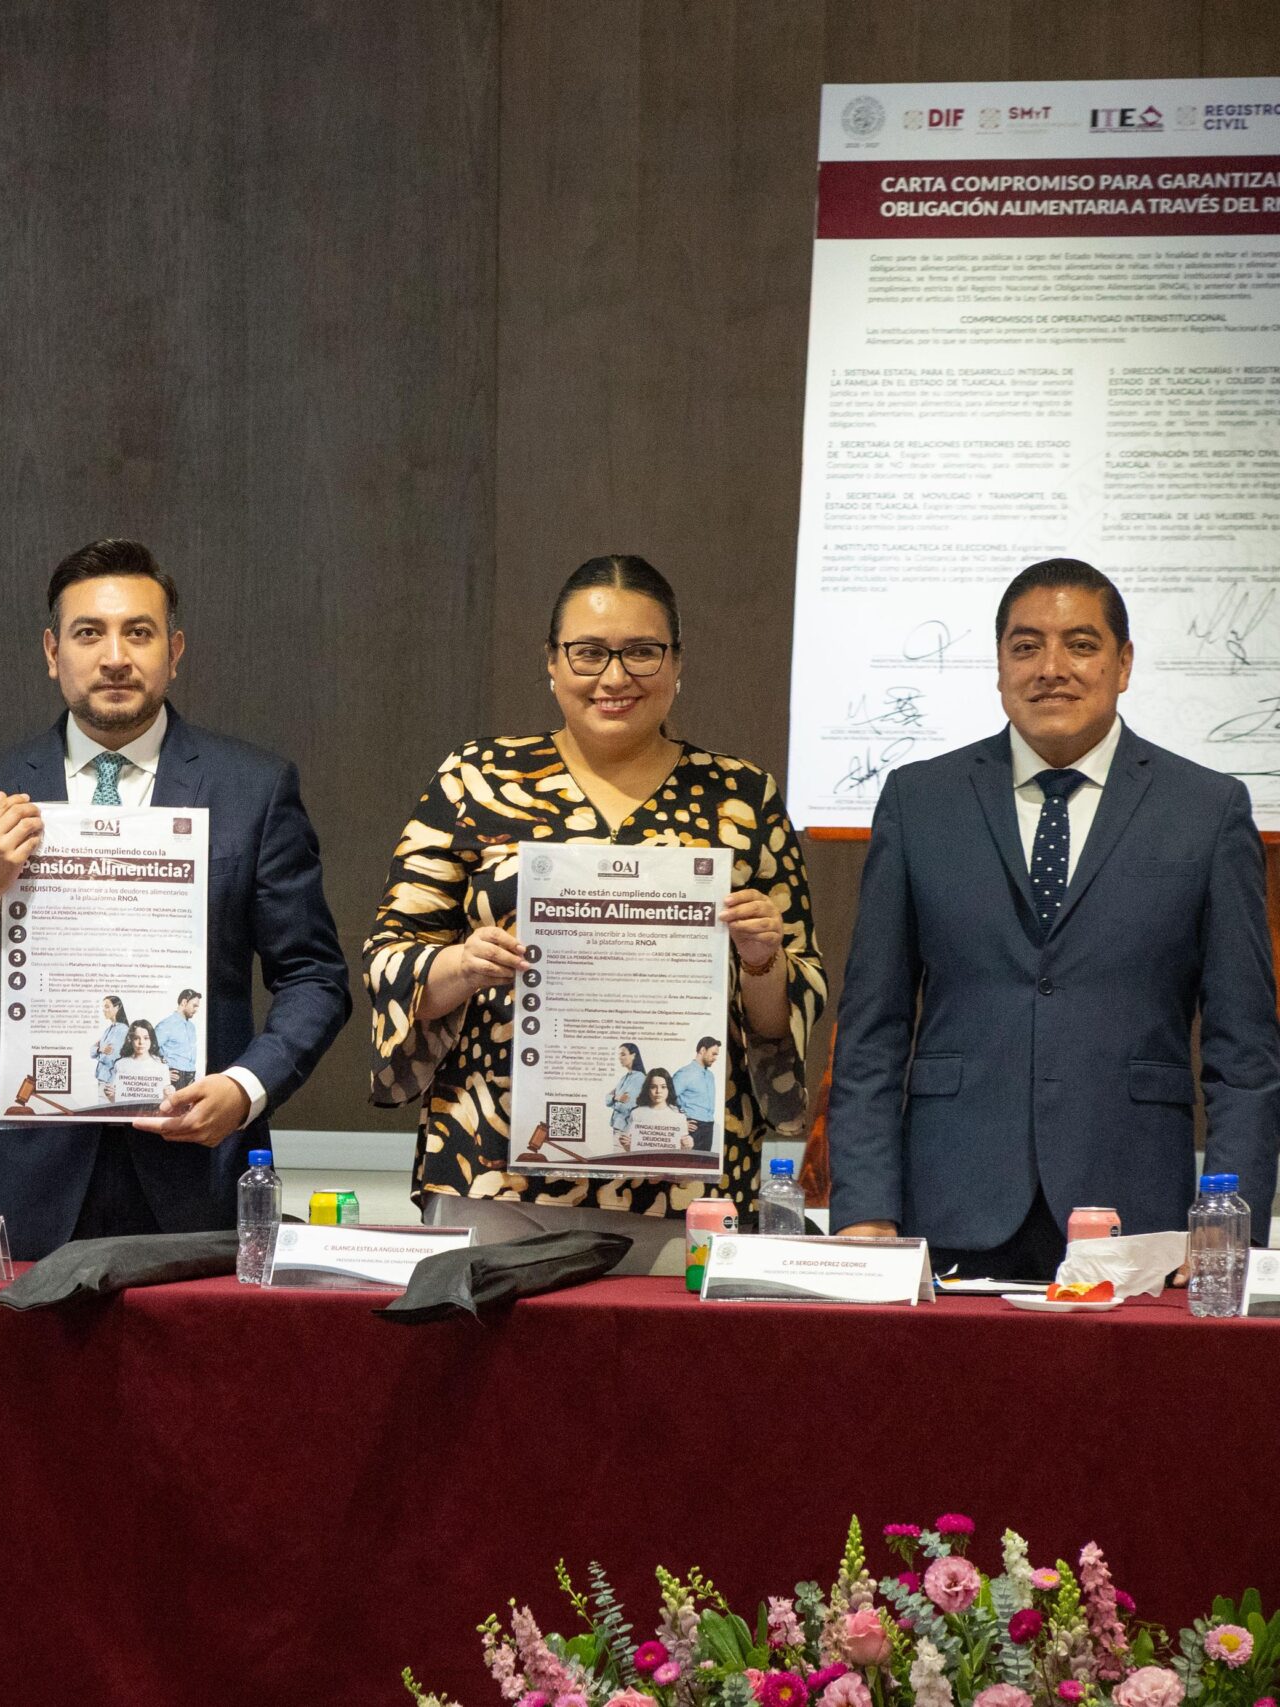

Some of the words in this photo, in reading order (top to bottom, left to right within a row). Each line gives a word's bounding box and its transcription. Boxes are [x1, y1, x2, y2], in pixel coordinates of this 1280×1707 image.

[928, 109, 965, 127] DIF
[1090, 108, 1137, 128] ITE
[1203, 118, 1249, 130] CIVIL
[880, 176, 947, 193] CARTA
[950, 174, 1095, 193] COMPROMISO
[1099, 174, 1153, 191] PARA
[880, 197, 998, 217] OBLIGACIÓN
[1000, 199, 1131, 216] ALIMENTARIA
[1131, 199, 1145, 214] A
[1148, 193, 1219, 214] TRAVÉS
[1223, 197, 1260, 213] DEL
[960, 316, 1033, 324] COMPROMISOS
[1051, 314, 1122, 323] OPERATIVIDAD
[1124, 313, 1227, 322] INTERINSTITUCIONAL
[94, 848, 141, 856] cumpliendo
[21, 858, 85, 875] Pensión
[88, 860, 191, 878] Alimenticia?
[612, 860, 639, 875] OAJ
[20, 885, 62, 893] REQUISITOS
[560, 888, 577, 897] ¿No
[612, 890, 660, 899] cumpliendo
[534, 902, 602, 918] Pensión
[604, 903, 712, 921] Alimenticia?
[13, 929, 21, 938] 2
[594, 930, 620, 938] inscribir
[599, 938, 634, 946] plataforma
[13, 954, 21, 962] 3
[13, 976, 21, 986] 4
[528, 974, 536, 982] 2
[528, 998, 536, 1006] 3
[13, 1007, 21, 1017] 5
[527, 1021, 535, 1031] 4
[526, 1053, 534, 1062] 5
